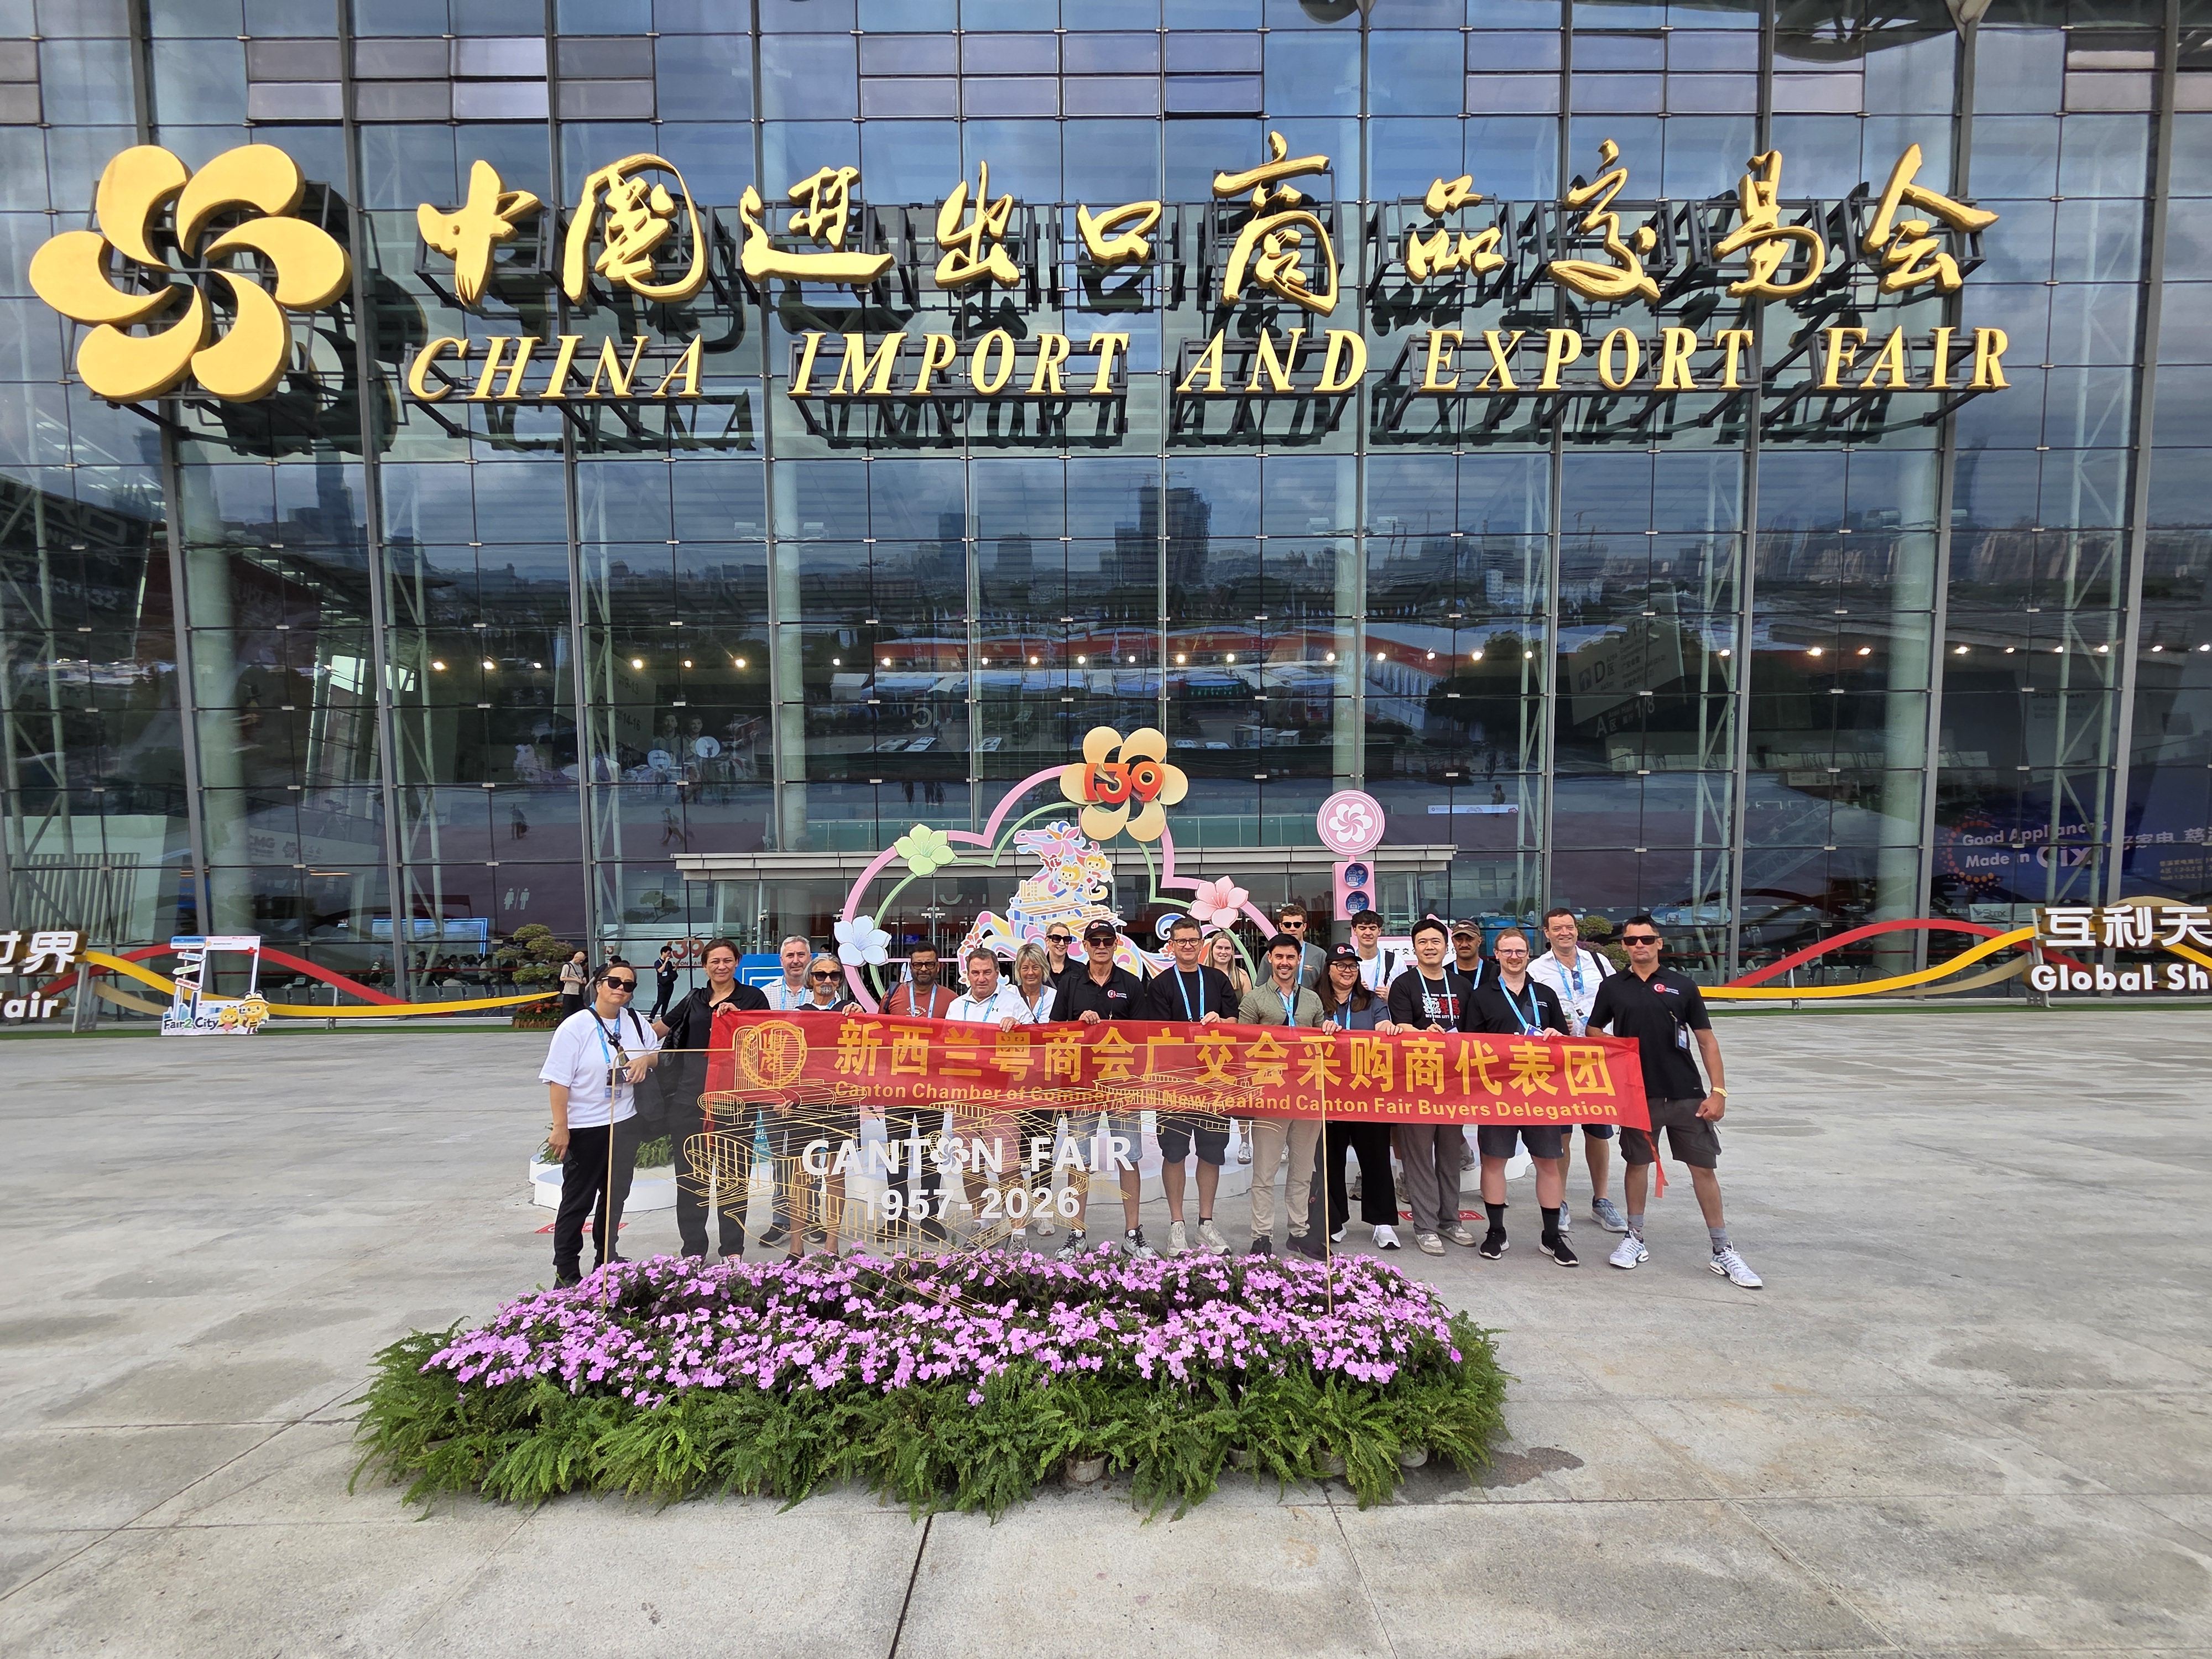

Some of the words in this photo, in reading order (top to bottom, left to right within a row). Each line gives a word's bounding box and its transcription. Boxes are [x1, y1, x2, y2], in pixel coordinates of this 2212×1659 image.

[407, 333, 703, 401] CHINA
[787, 329, 1130, 397] IMPORT
[1176, 327, 1369, 394] AND
[1418, 326, 1754, 394] EXPORT
[1817, 324, 2011, 392] FAIR
[1596, 716, 1608, 738] A
[1083, 760, 1164, 804] 139
[1963, 830, 2005, 846] Good
[2008, 821, 2107, 843] Applancs
[1965, 852, 2010, 868] Made
[2031, 964, 2153, 991] Global
[0, 991, 59, 1019] air
[195, 1016, 220, 1030] City
[834, 1018, 1616, 1097] 新西兰粤商会广交会采购商代表团
[835, 1080, 906, 1098] Canton
[912, 1082, 1001, 1100] Chamber
[1006, 1085, 1026, 1100] of
[1212, 1091, 1291, 1110] Zealand
[1295, 1094, 1368, 1113] Canton
[1374, 1097, 1412, 1114] Fair
[1417, 1099, 1491, 1119] Buyers
[1495, 1100, 1618, 1120] Delegation
[1030, 1136, 1135, 1172] FAIR
[867, 1186, 1080, 1221] 1957-2026
